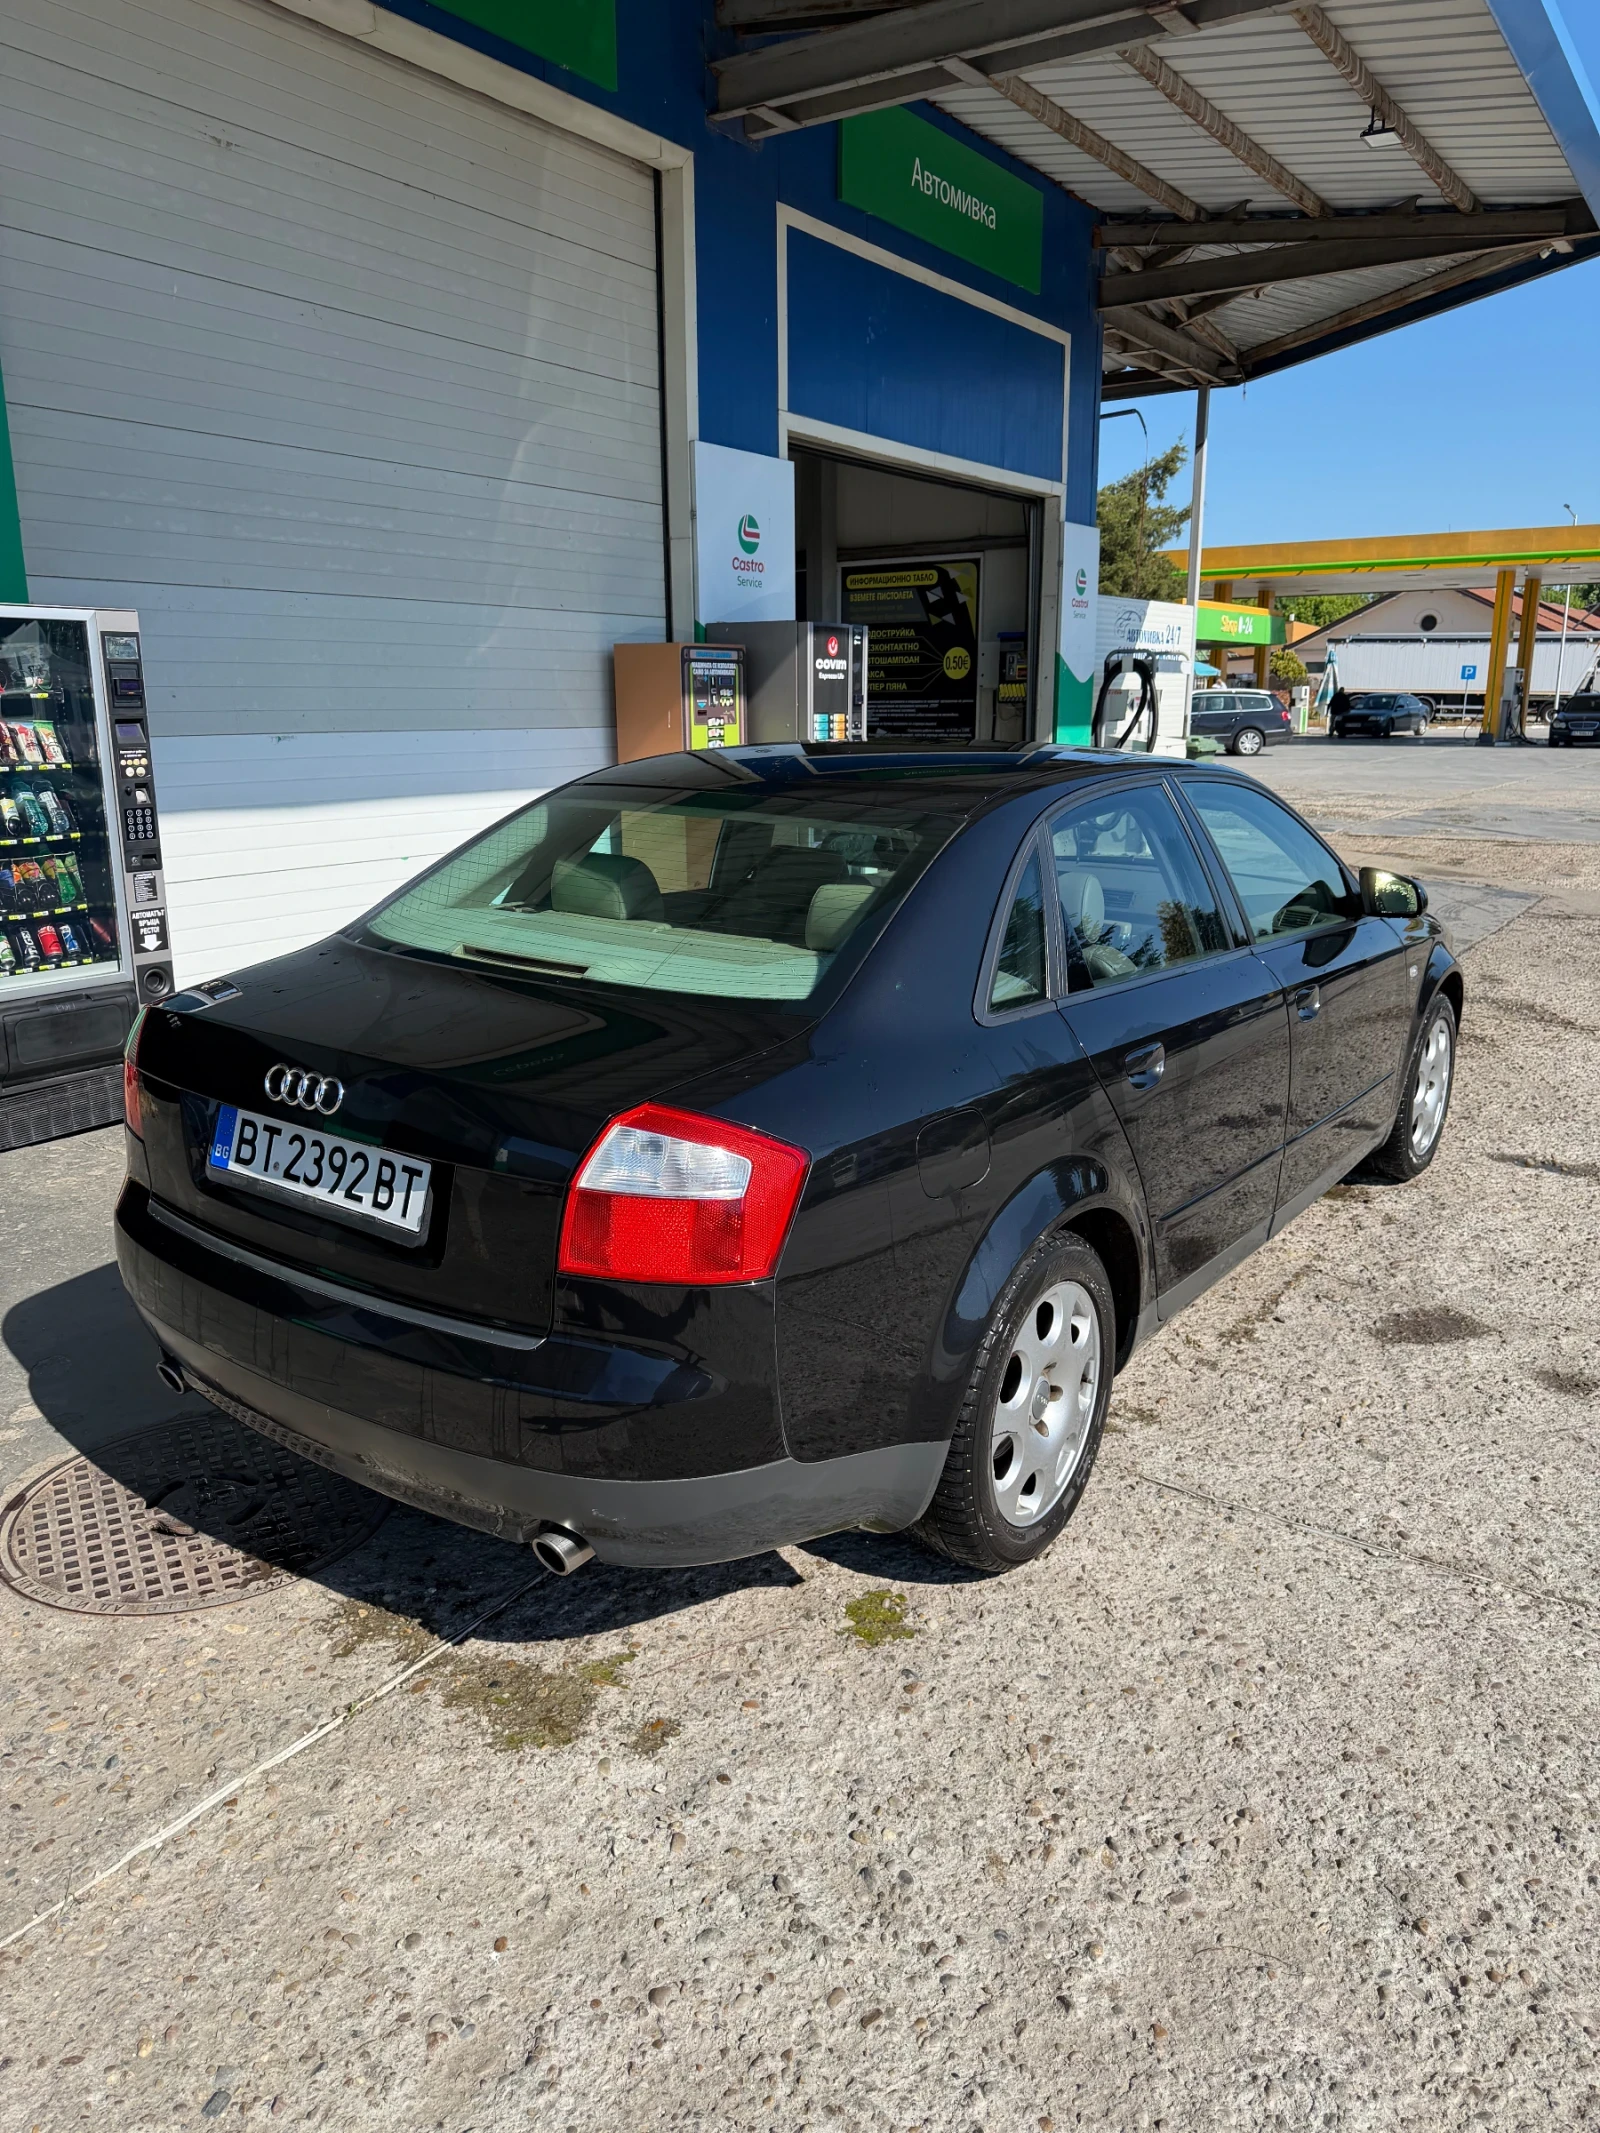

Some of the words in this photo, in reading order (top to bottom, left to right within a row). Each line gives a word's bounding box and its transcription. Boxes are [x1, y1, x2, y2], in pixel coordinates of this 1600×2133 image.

[911, 157, 996, 230] Автомивка
[737, 575, 763, 588] Service
[850, 574, 912, 586] ИНФОРМАЦИОННО
[913, 573, 934, 583] ТАБЛО
[876, 590, 914, 601] ПИСТОЛЕТА
[867, 627, 916, 639] ОДОСТРУЙКА
[867, 642, 920, 652] ЕЗКОНТАКТНО
[867, 655, 920, 665] ВТОШАМПОАН
[945, 655, 969, 670] 0.50€
[867, 670, 886, 678] АКСА
[1464, 667, 1474, 678] P
[886, 682, 908, 691] ПЯНА
[214, 1143, 230, 1159] BG
